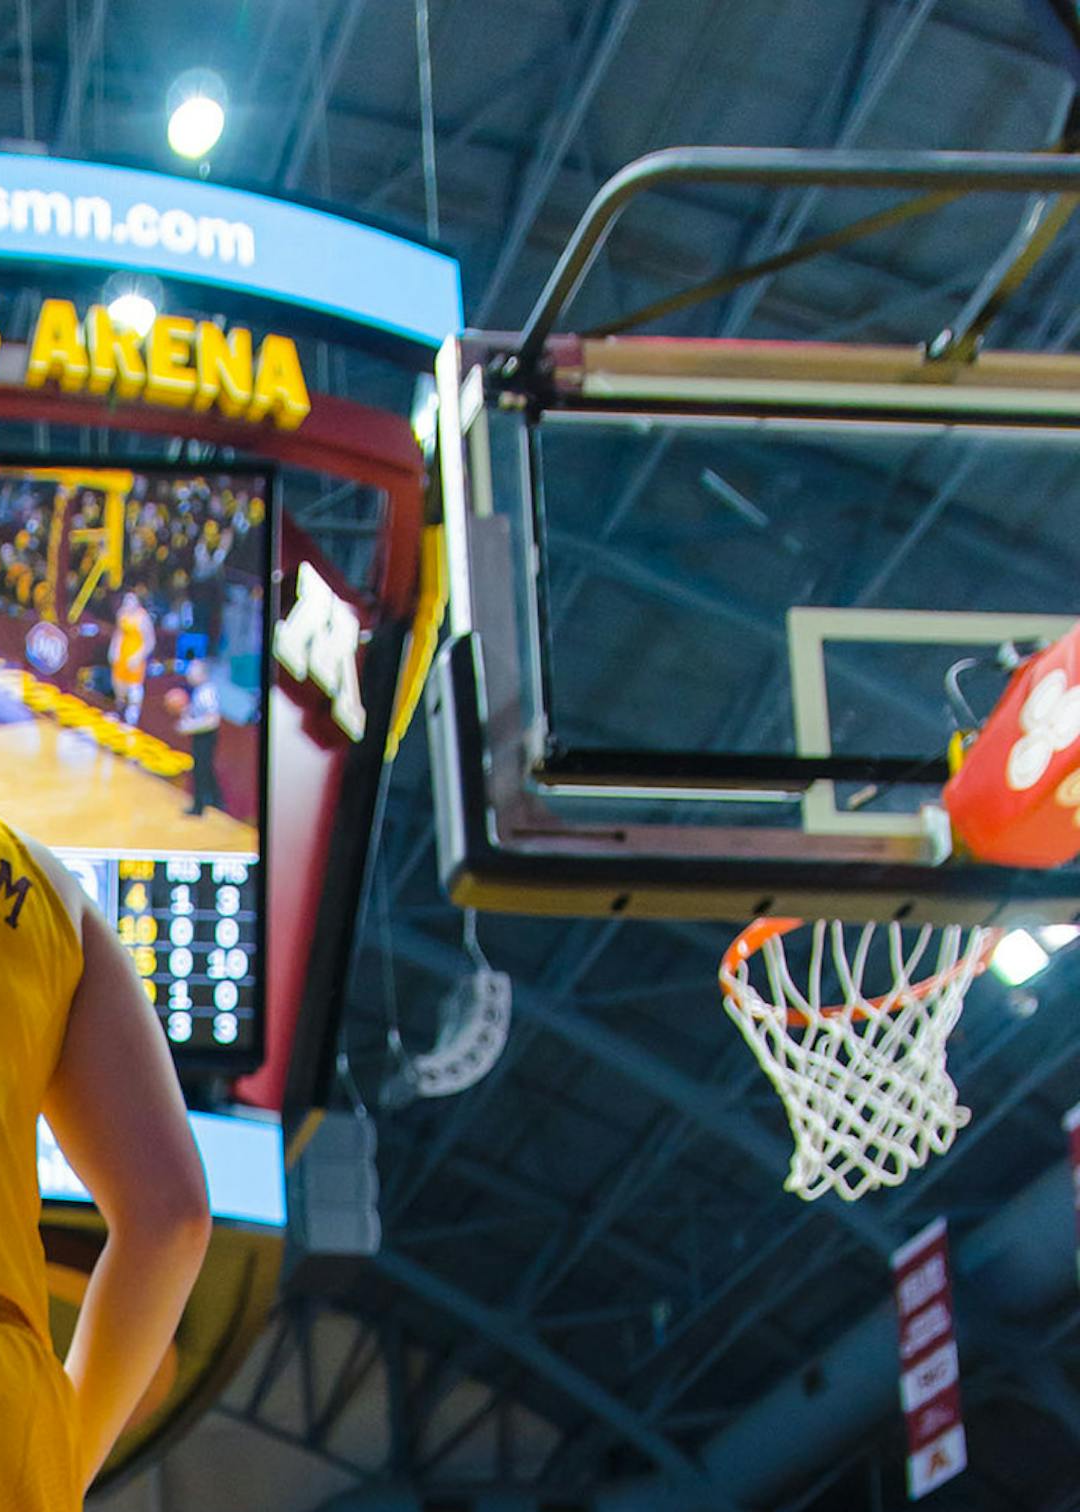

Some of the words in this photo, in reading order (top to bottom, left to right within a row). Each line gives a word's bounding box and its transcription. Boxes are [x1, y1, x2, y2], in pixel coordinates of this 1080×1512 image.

[25, 298, 312, 431] ARENA
[171, 884, 195, 915] 1
[170, 917, 194, 948] 0
[215, 918, 239, 949] 0
[169, 948, 193, 978] 0
[207, 949, 249, 979] 10
[169, 980, 193, 1010] 1
[214, 980, 238, 1011] 0
